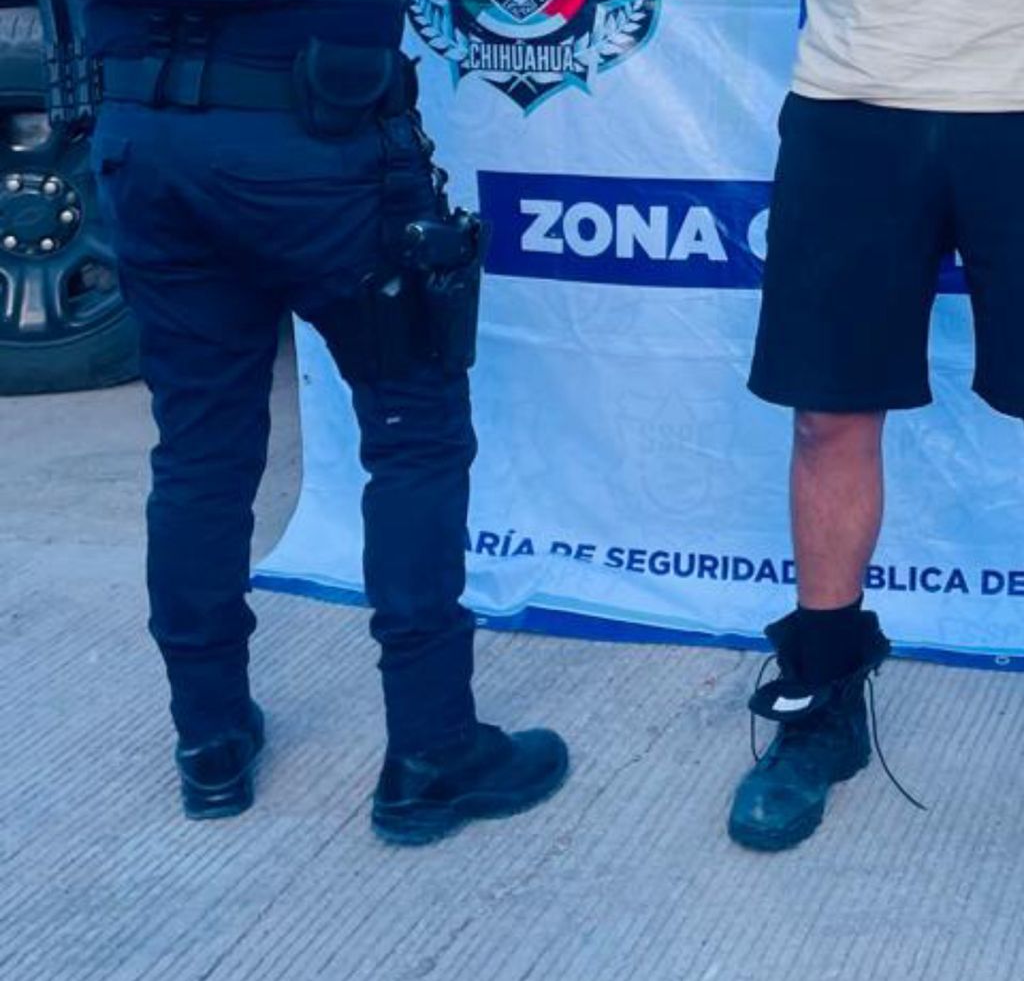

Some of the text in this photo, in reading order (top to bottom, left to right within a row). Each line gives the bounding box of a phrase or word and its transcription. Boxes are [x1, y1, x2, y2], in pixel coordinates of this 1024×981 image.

[470, 42, 575, 71] CHIHUAHUA
[518, 199, 728, 261] ZONA
[864, 564, 970, 595] BLICA
